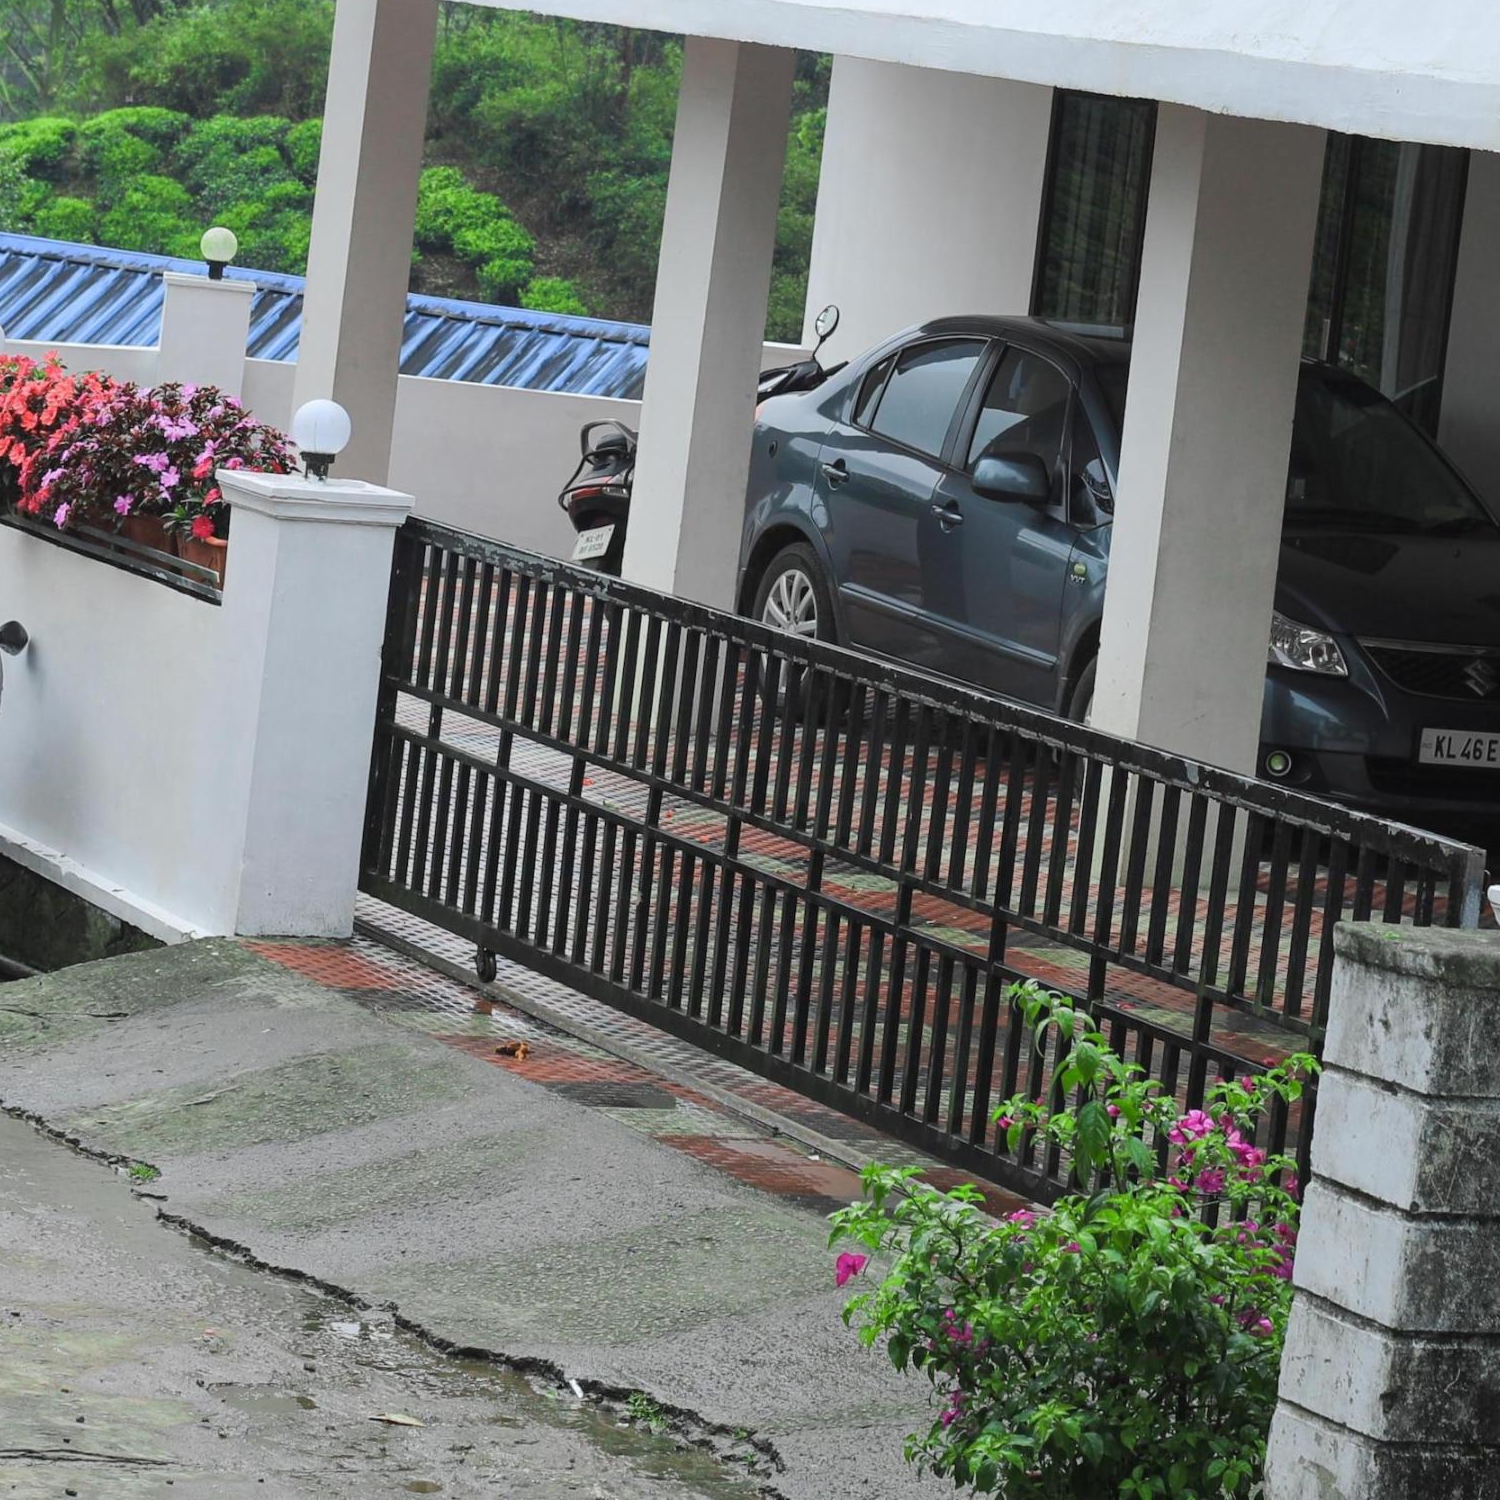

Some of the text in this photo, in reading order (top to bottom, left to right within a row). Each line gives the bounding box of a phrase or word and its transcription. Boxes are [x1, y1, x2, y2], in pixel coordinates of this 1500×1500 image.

[1434, 735, 1456, 759] KL
[1460, 737, 1483, 760] 46
[1486, 739, 1498, 762] E
